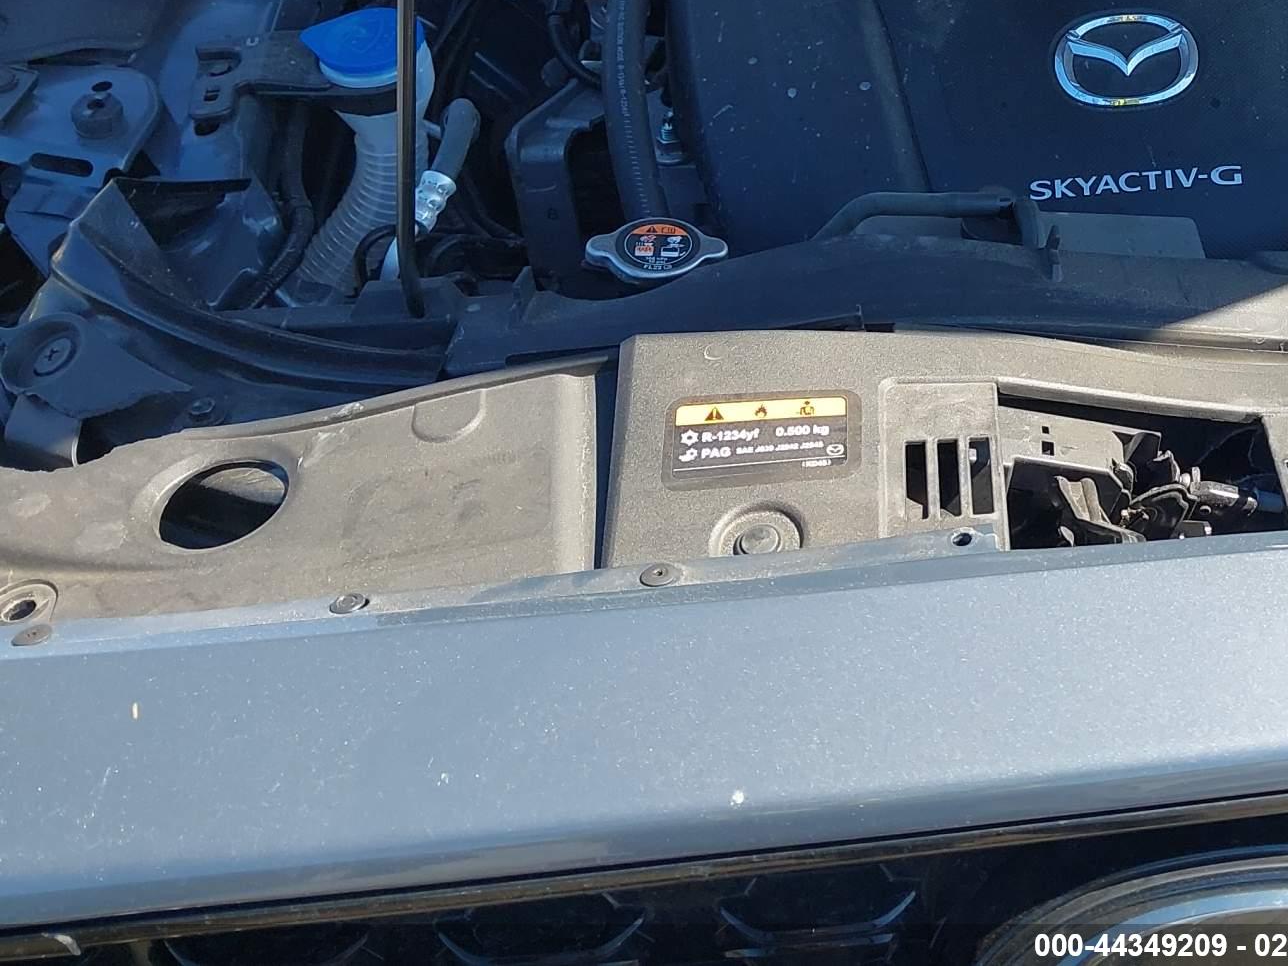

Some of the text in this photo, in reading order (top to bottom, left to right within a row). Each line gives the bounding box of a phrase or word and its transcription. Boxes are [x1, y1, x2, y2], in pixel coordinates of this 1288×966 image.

[1029, 165, 1243, 200] SKYACTIV-G
[702, 428, 760, 442] R-1234yf
[813, 424, 829, 436] kg
[701, 447, 731, 458] PAG
